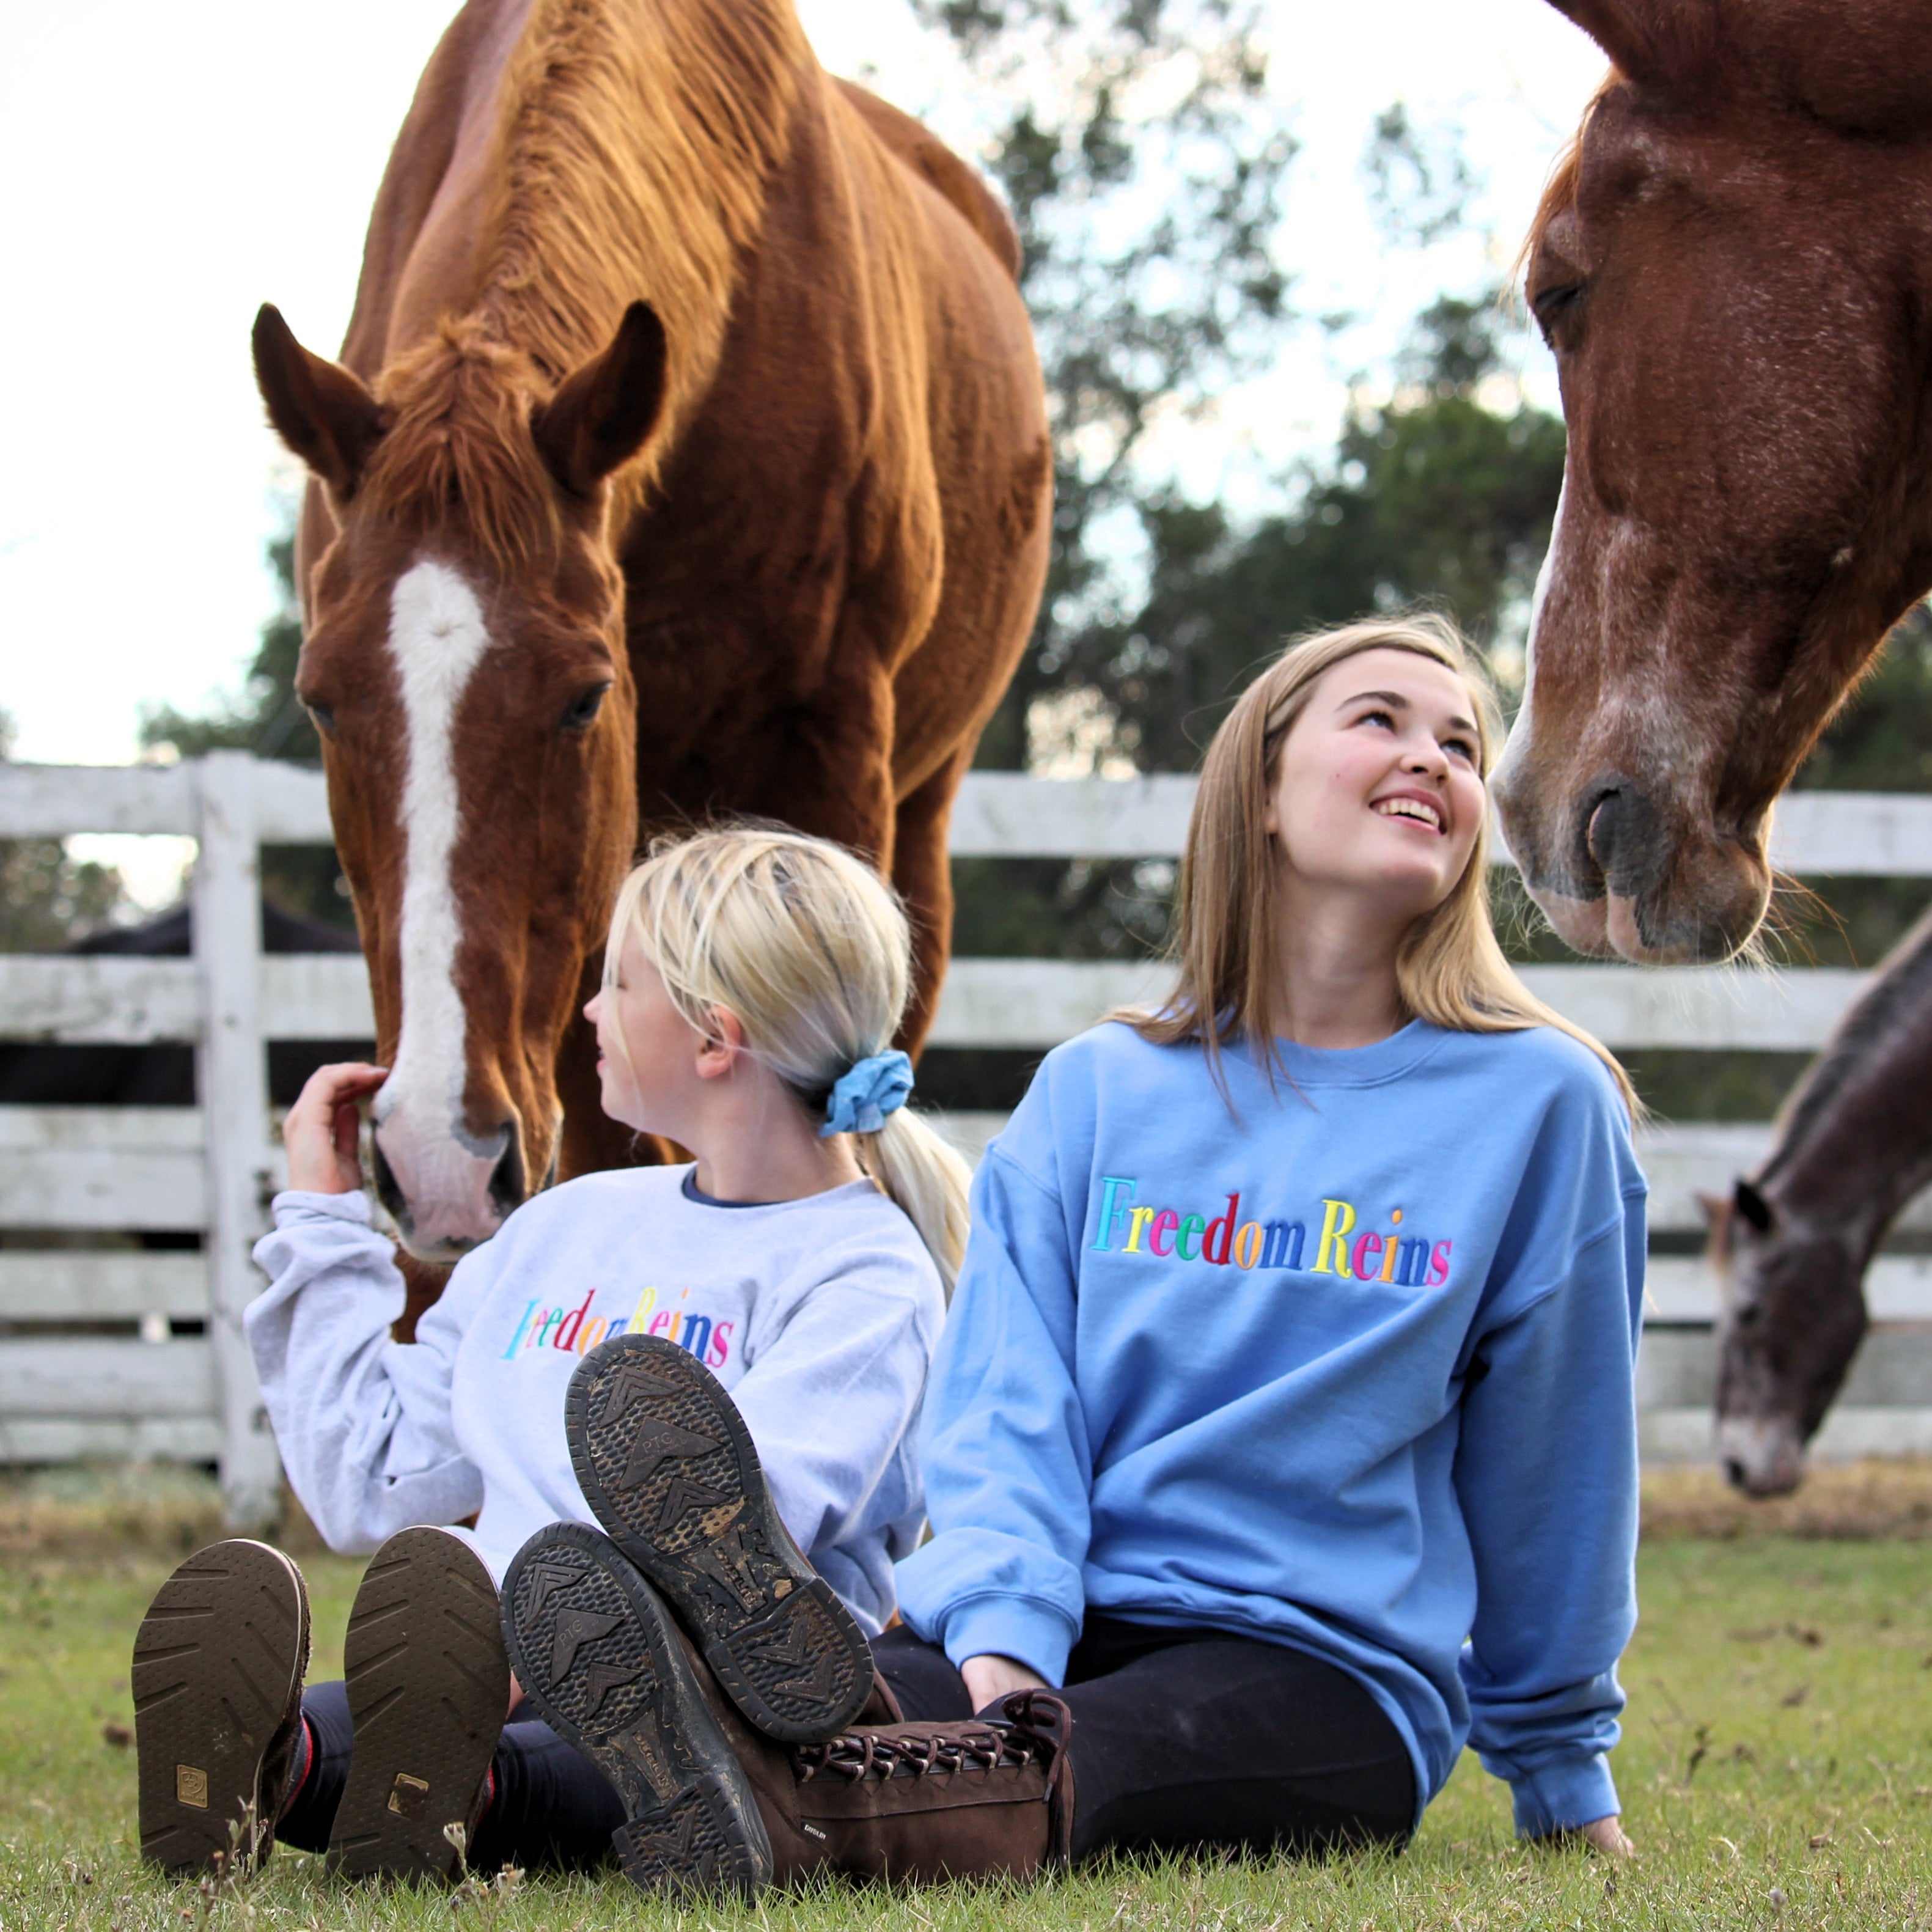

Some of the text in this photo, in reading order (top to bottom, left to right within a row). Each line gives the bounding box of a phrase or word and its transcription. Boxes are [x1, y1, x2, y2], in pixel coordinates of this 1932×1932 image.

[1089, 1176, 1453, 1287] Freedom Reins
[500, 1288, 630, 1361] Feedo
[642, 1432, 672, 1453] PTG
[559, 1619, 582, 1646] PTG
[633, 1732, 672, 1790] DUBLIN
[804, 1824, 826, 1840] DUBLIN
